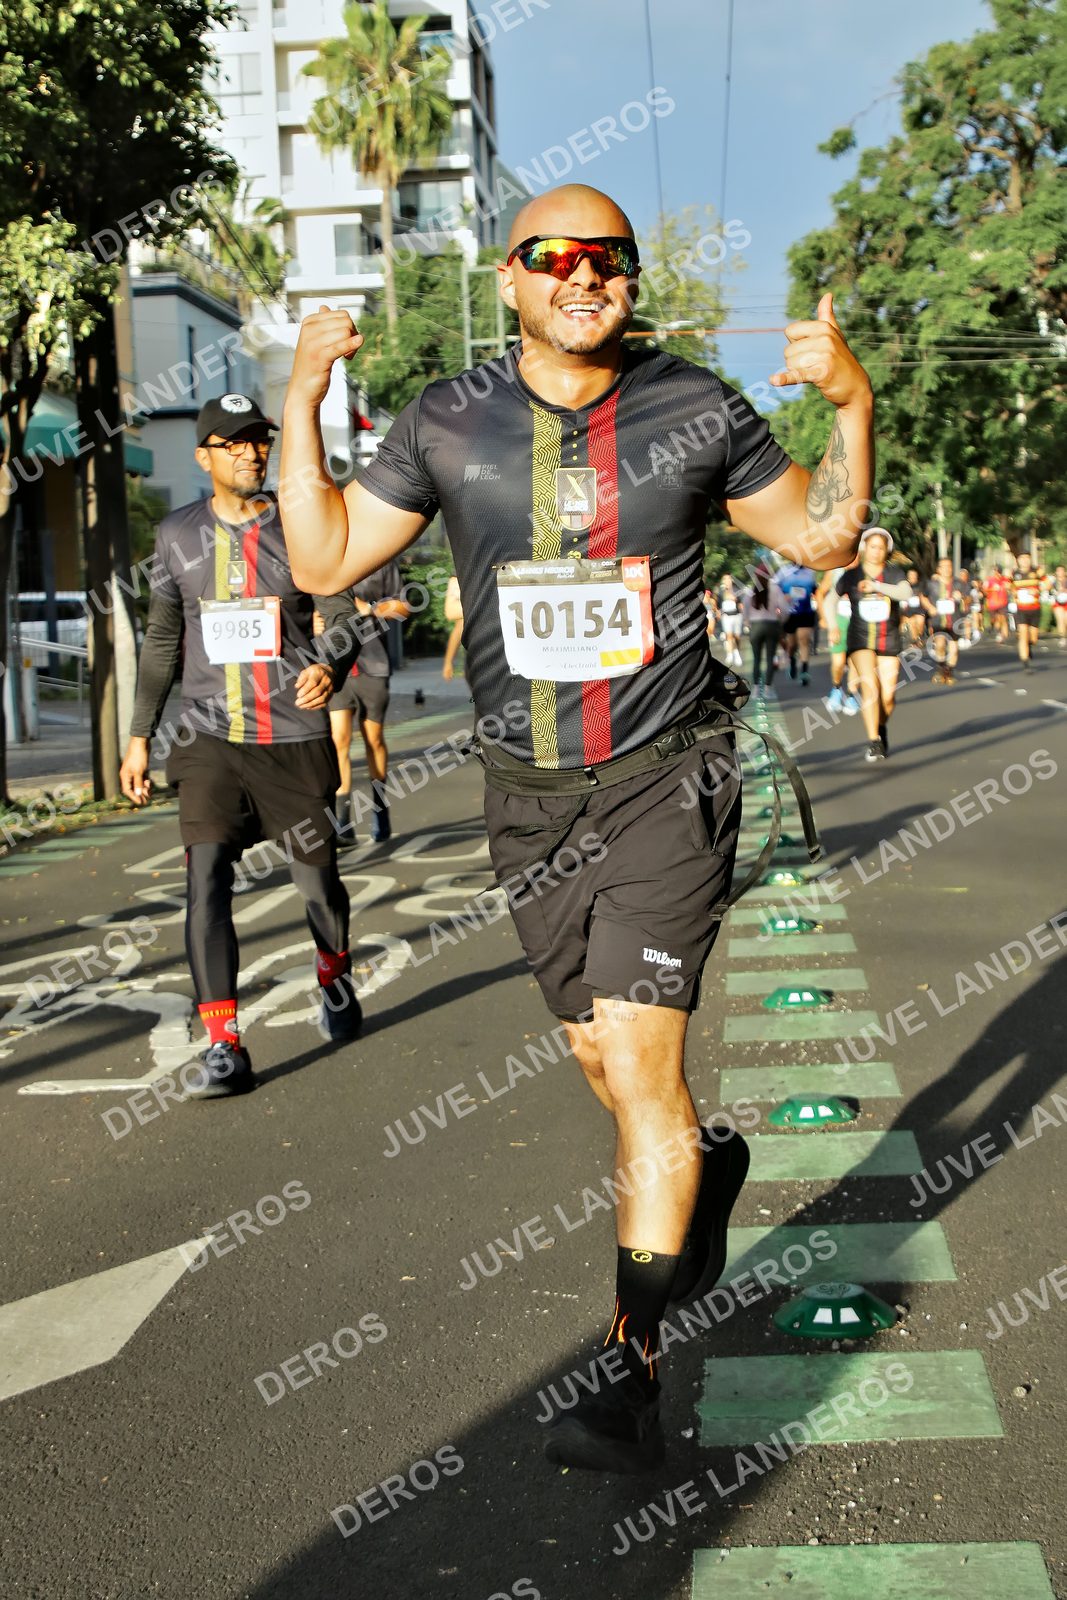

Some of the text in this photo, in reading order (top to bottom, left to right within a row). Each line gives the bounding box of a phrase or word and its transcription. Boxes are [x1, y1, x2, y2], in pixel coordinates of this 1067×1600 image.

[508, 598, 633, 639] 10154
[212, 619, 262, 641] 9985
[542, 645, 598, 653] MAXIMILIANO
[643, 947, 682, 968] Wilson
